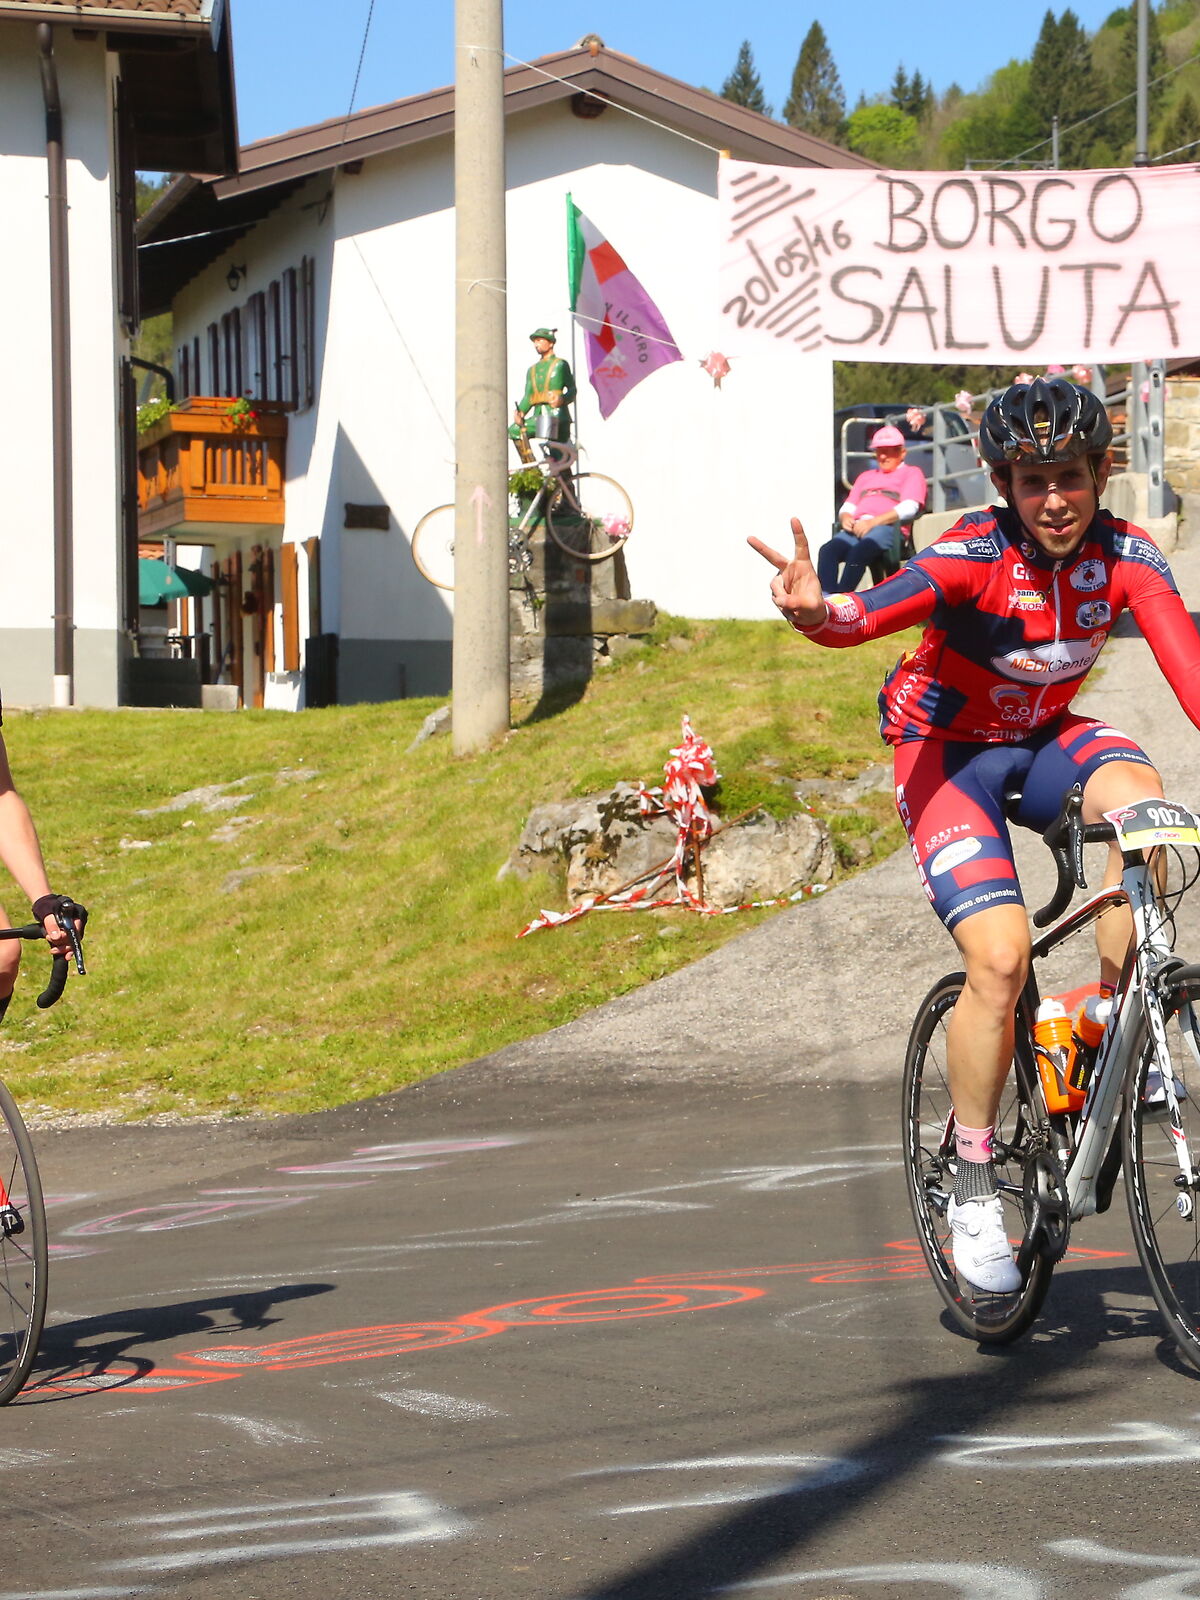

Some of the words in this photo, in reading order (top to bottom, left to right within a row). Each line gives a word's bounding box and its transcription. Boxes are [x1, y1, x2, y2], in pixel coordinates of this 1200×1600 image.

[875, 173, 1144, 253] BORGO
[825, 262, 1181, 350] SALUTA
[1146, 806, 1186, 827] 902
